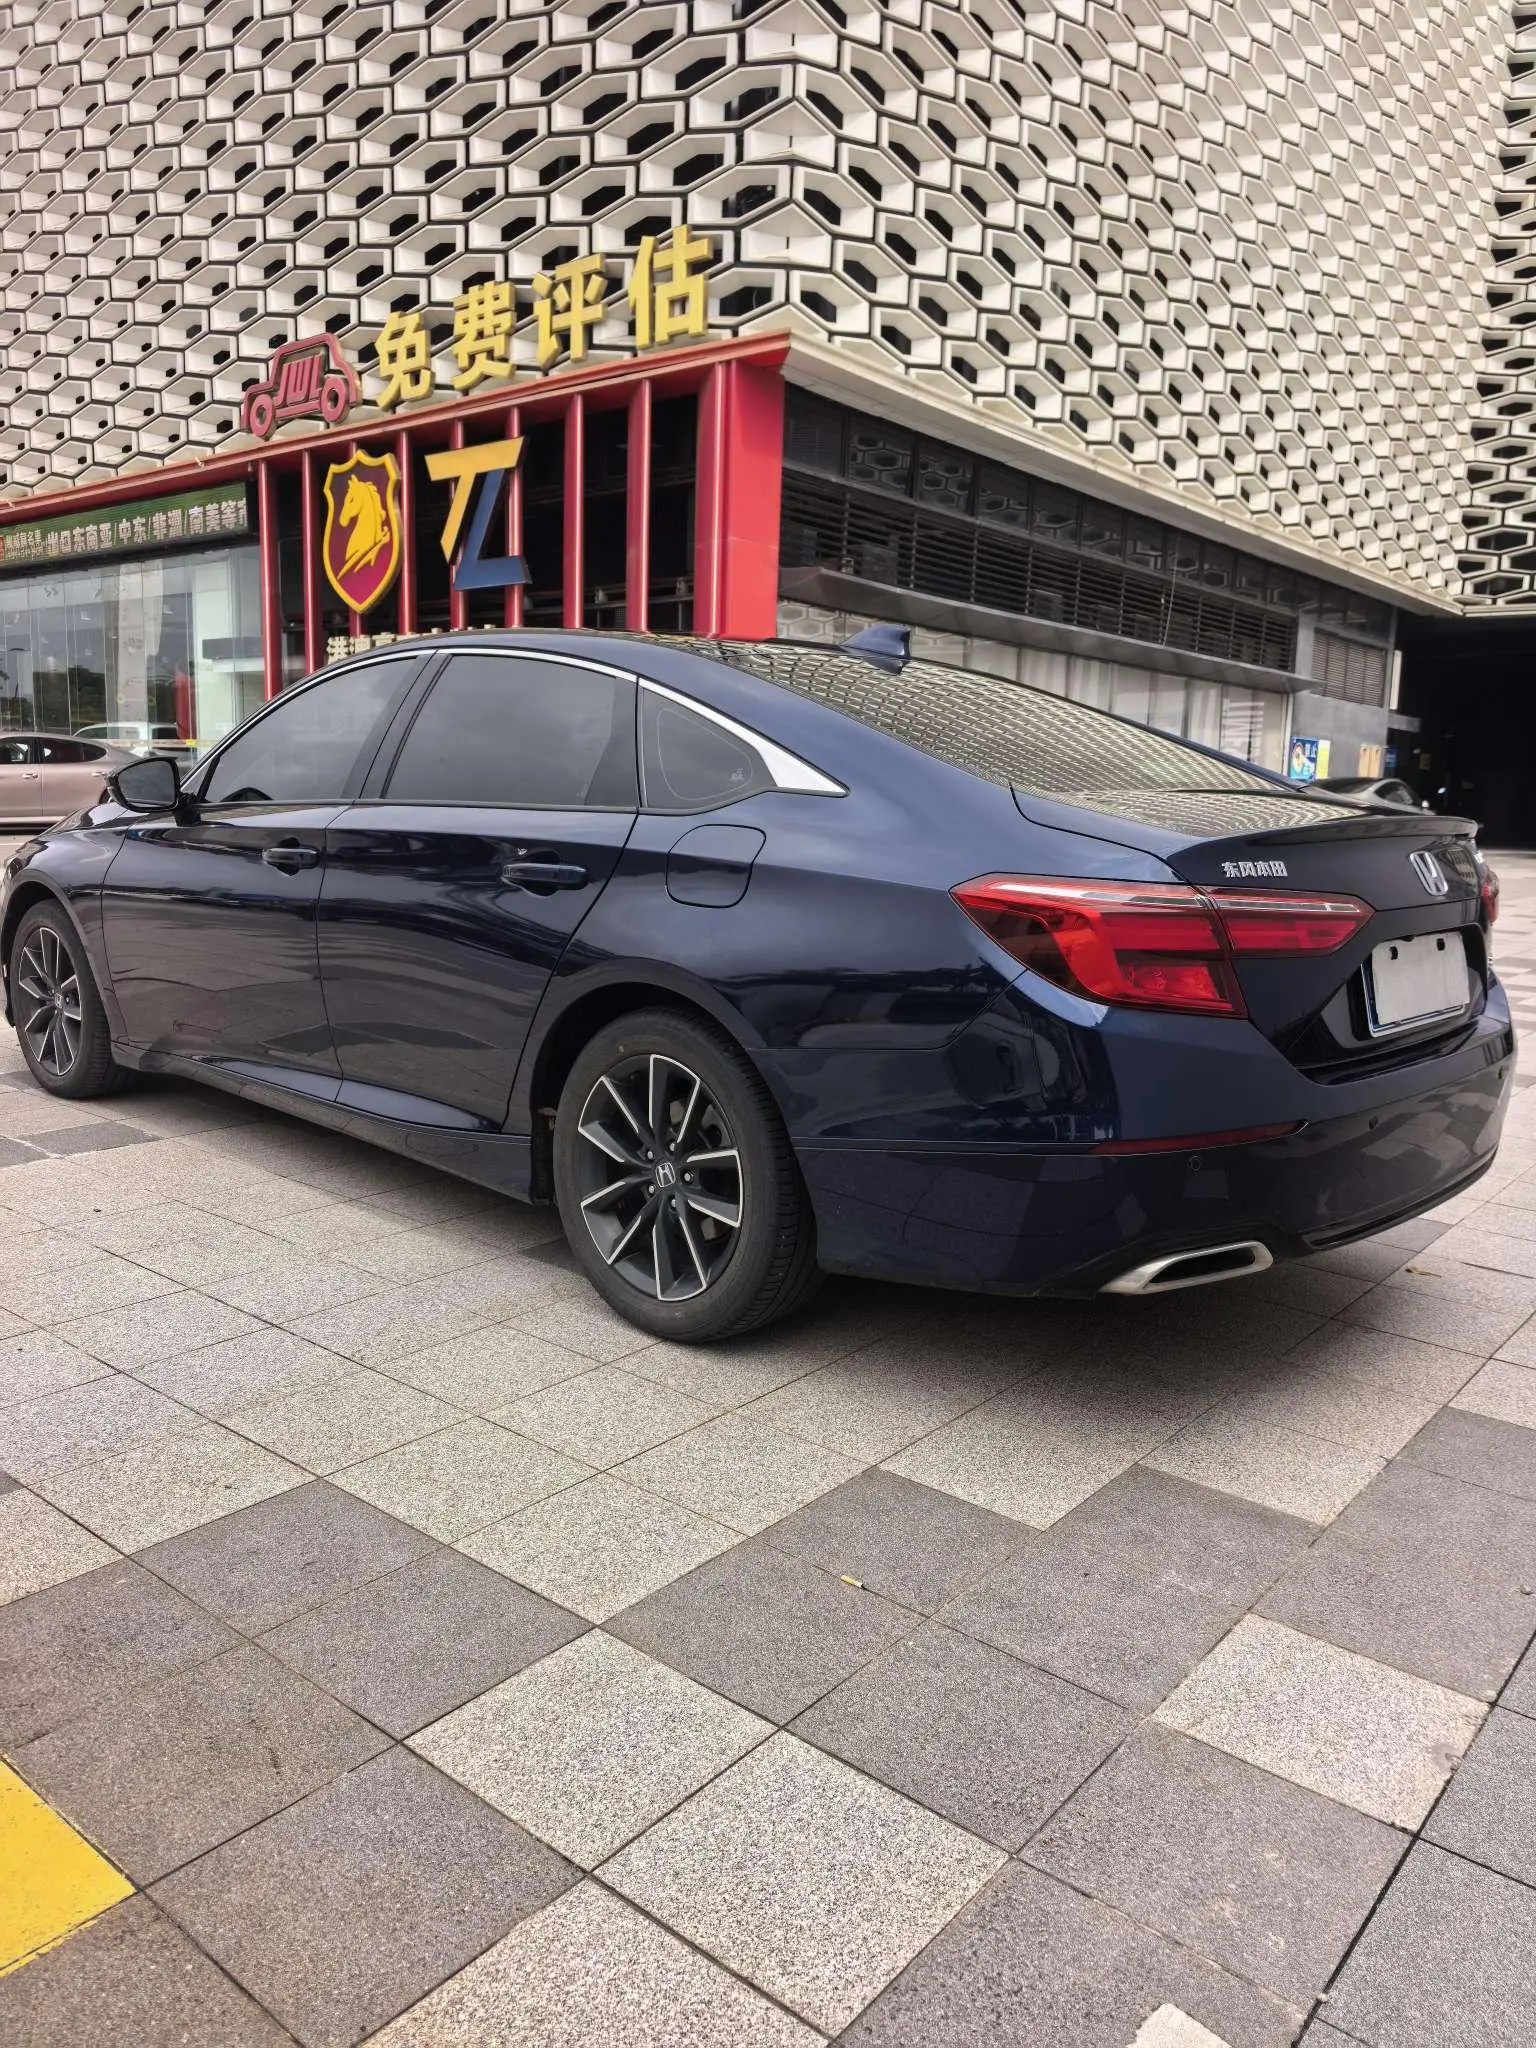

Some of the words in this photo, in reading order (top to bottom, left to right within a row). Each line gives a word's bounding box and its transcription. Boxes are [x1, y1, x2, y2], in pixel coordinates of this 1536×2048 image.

[374, 224, 713, 411] 免费评估
[1221, 860, 1288, 878] 东风本田
